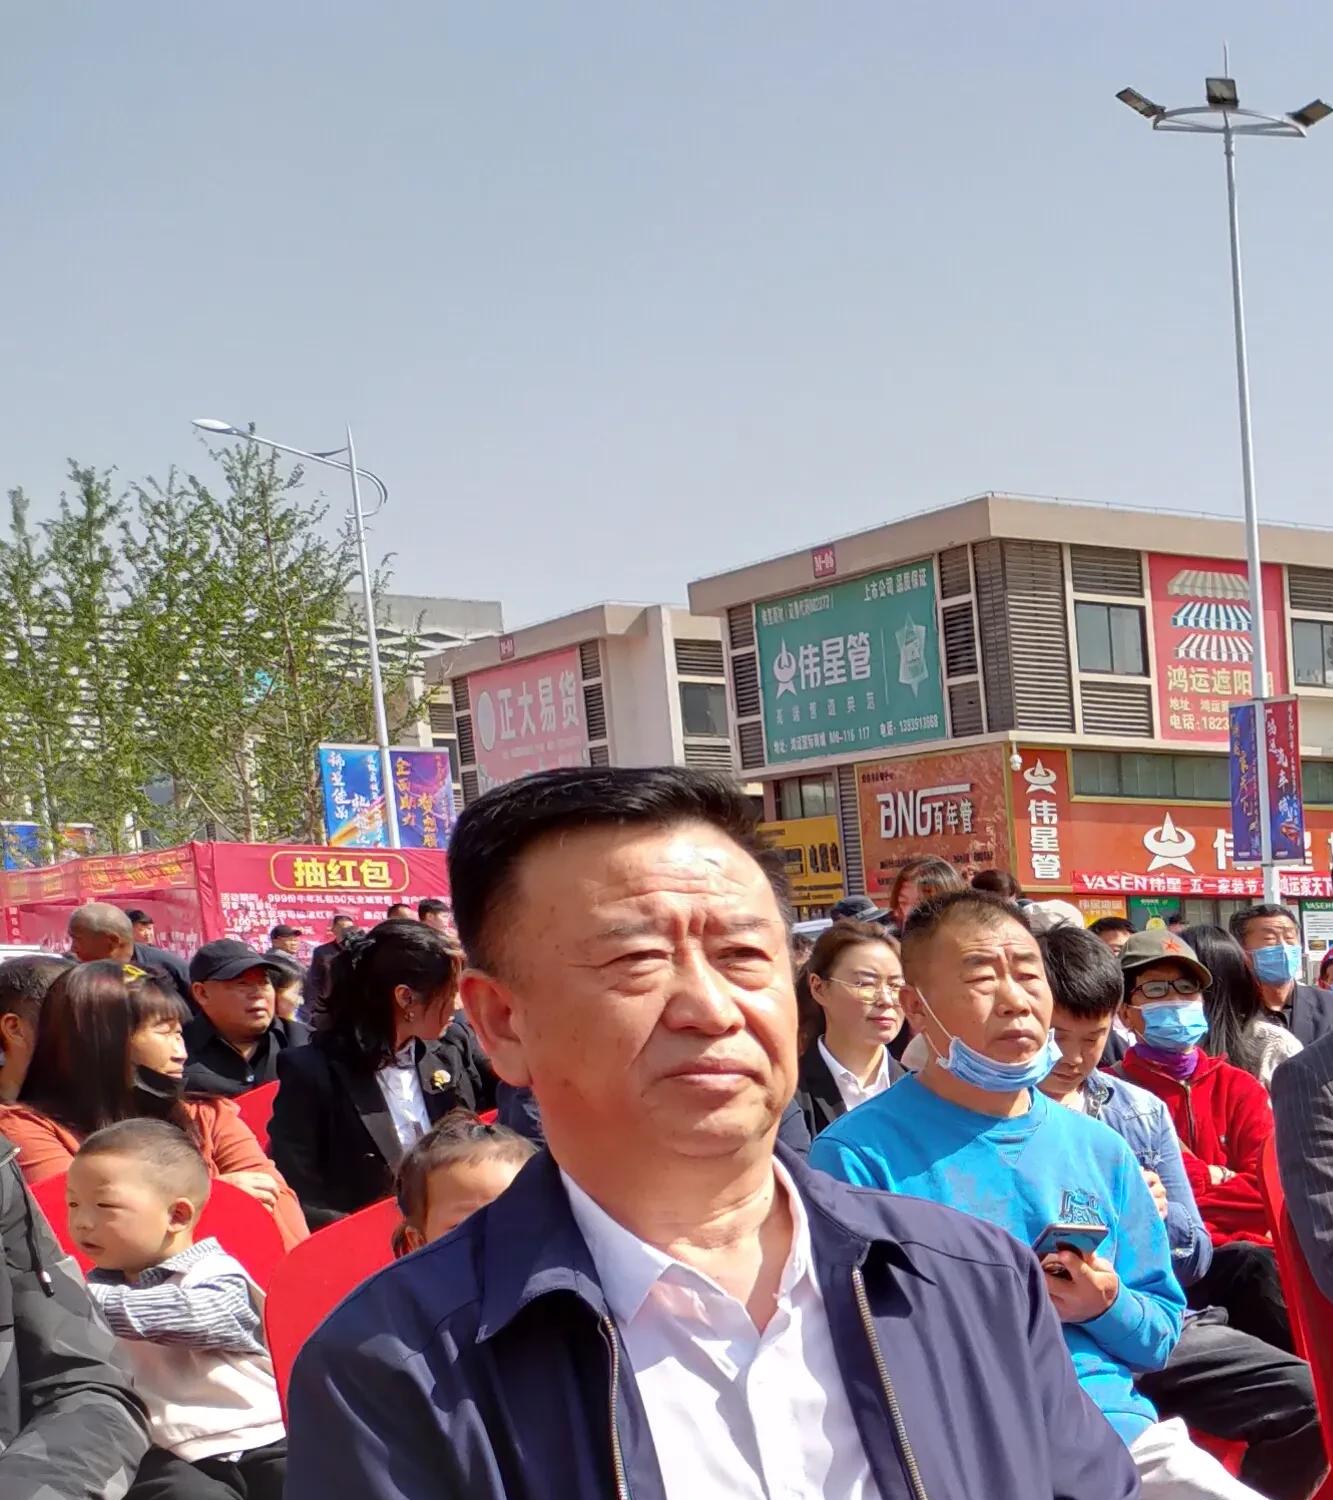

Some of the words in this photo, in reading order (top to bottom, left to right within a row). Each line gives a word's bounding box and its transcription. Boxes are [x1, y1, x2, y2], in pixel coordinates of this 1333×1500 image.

[798, 632, 872, 691] 伟星管
[497, 670, 580, 741] 正大易货
[1028, 799, 1061, 881] 伟星管
[293, 857, 392, 888] 抽红包
[1082, 874, 1148, 892] VASEN
[1150, 877, 1183, 893] 伟星
